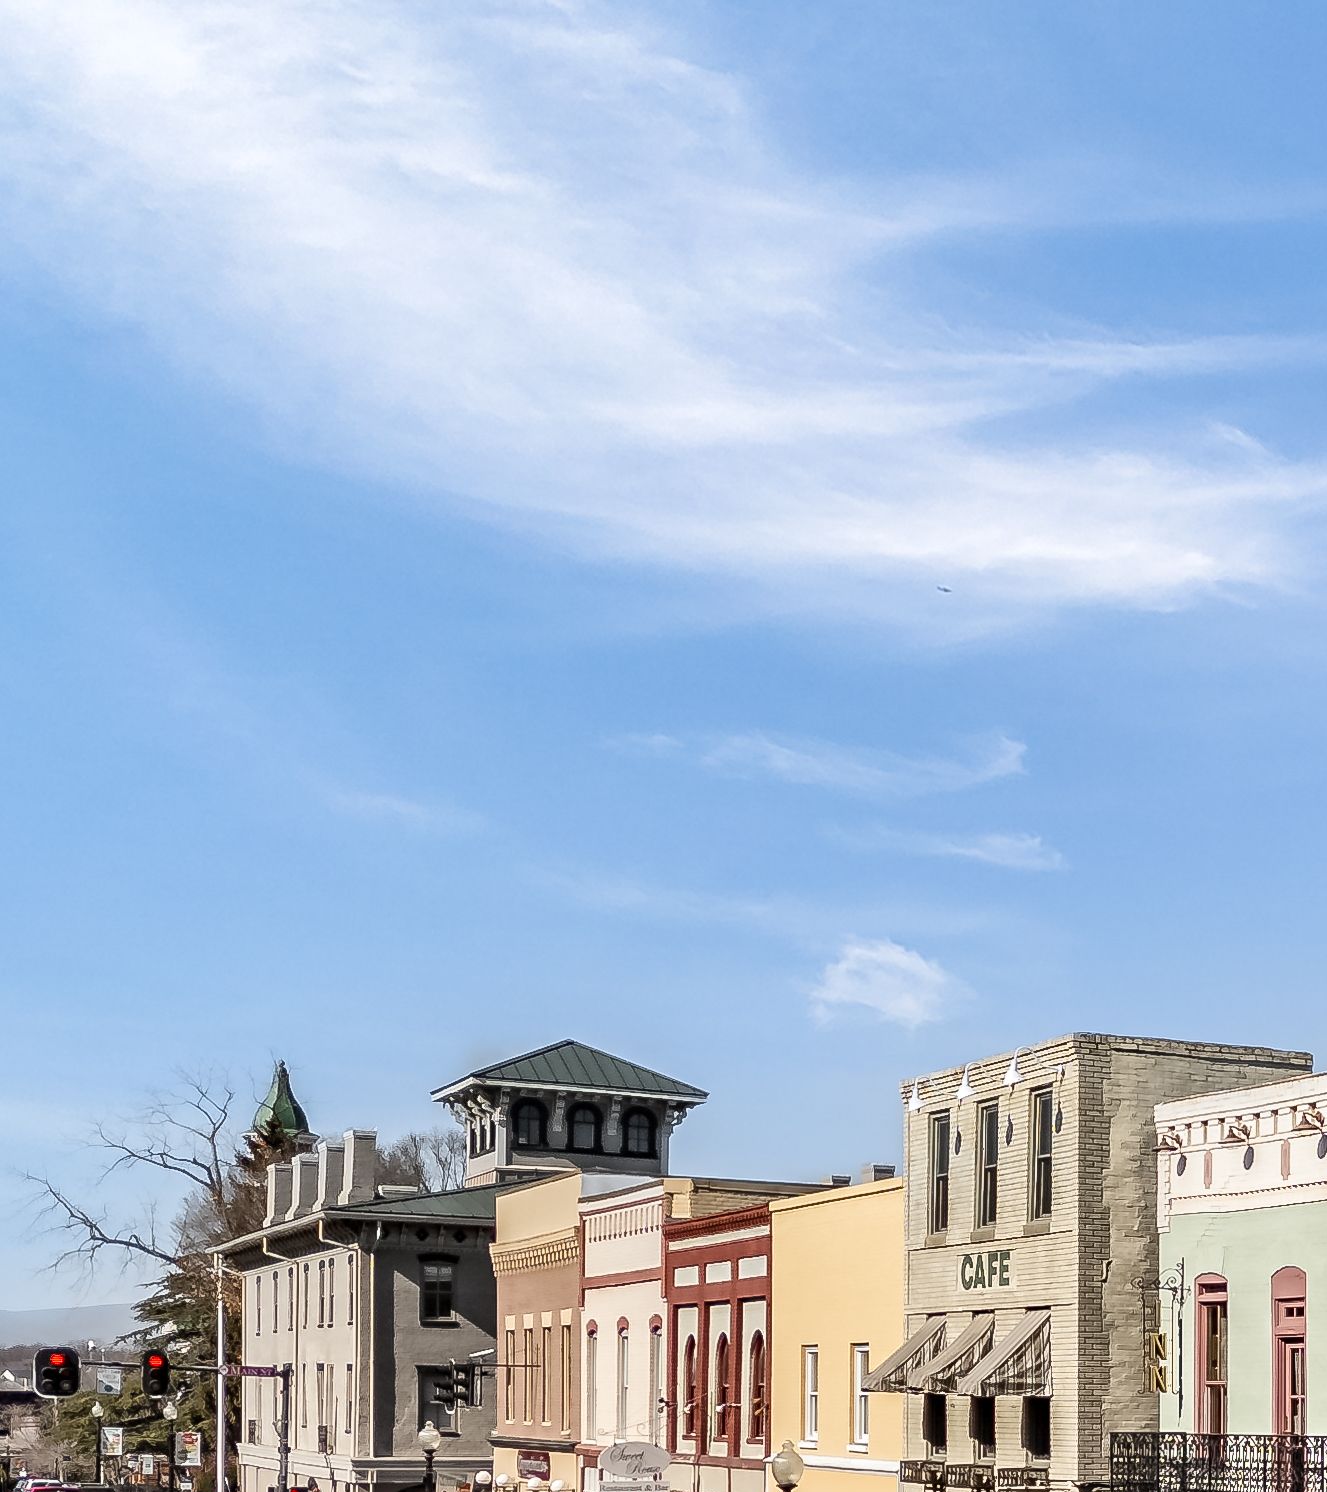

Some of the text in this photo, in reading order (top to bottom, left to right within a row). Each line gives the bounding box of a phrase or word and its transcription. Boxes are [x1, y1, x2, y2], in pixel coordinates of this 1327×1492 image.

[961, 1251, 1011, 1291] CAFE
[644, 1484, 653, 1492] &
[655, 1484, 670, 1492] Bar
